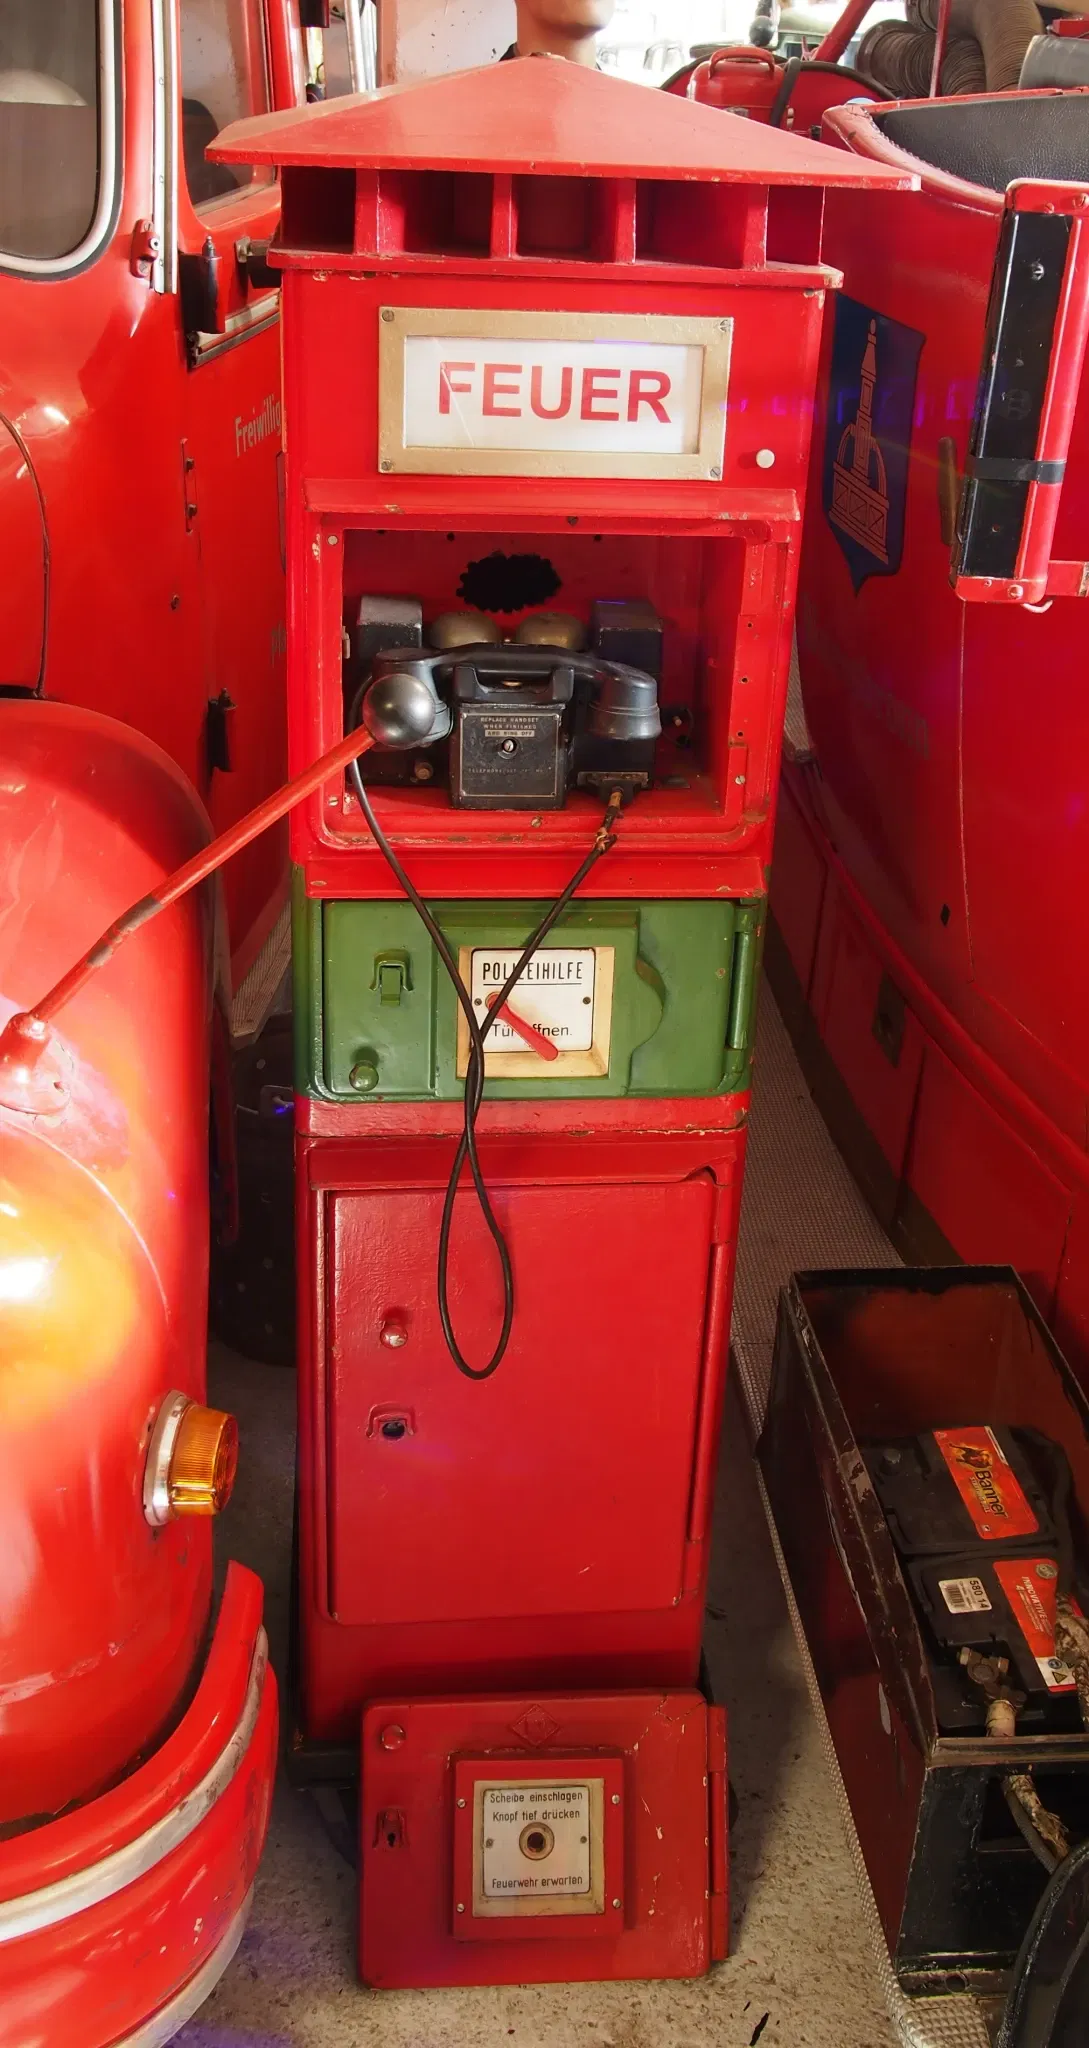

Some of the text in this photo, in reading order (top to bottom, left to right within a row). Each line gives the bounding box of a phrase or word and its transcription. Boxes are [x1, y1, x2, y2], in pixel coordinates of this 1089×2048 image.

[439, 361, 672, 424] FEUER
[975, 1471, 1008, 1517] Banner
[969, 1580, 991, 1609] 580 14
[1022, 1576, 1048, 1619] INNOVATIVE
[490, 1791, 583, 1803] Scheibe einschlagen
[492, 1809, 580, 1823] Knopf tief drücken
[492, 1875, 583, 1889] Feuerwehr erwarten
